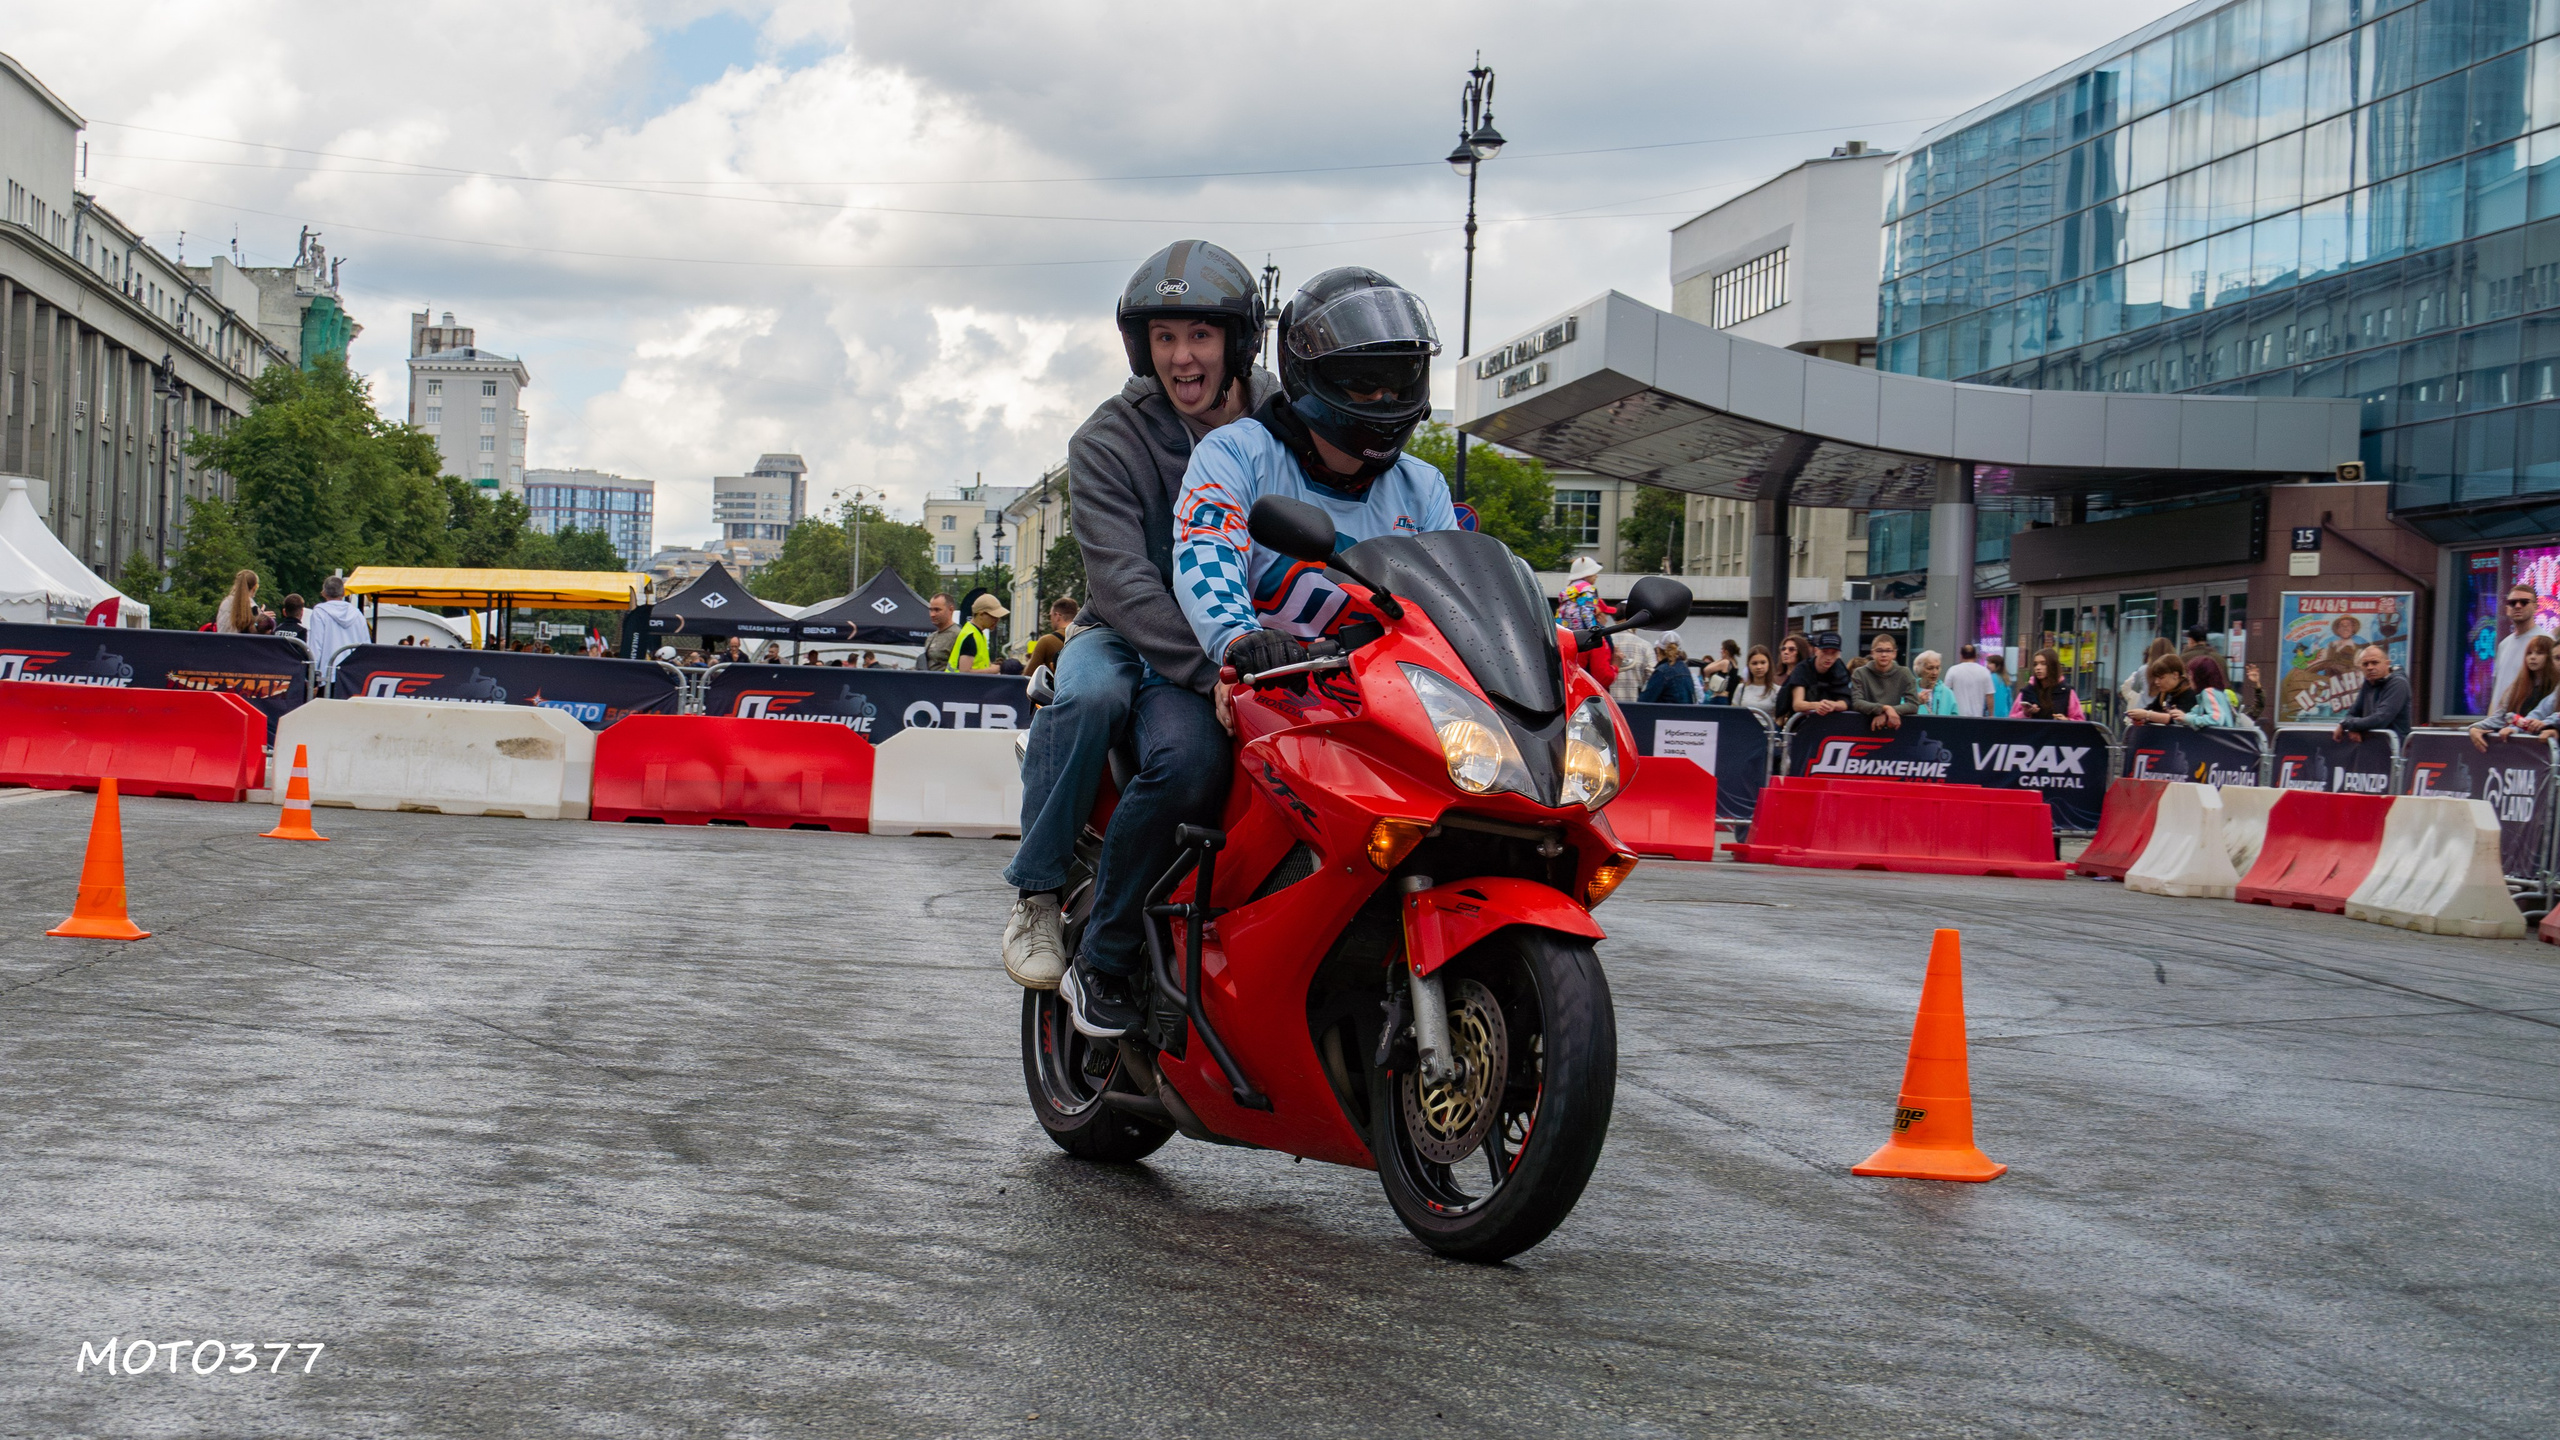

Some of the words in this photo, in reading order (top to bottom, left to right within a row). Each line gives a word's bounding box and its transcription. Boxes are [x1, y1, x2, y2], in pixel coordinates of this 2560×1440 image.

[2296, 530, 2315, 543] 15
[2300, 599, 2348, 611] 2/4/8/9
[737, 624, 764, 632] UNLEASH
[1257, 695, 1304, 719] HONDA
[1665, 729, 1708, 737] Ирбитский
[1810, 742, 1952, 778] ДВИЖЕНИЕ
[1972, 743, 2091, 774] VIRAX
[2018, 775, 2084, 788] CAPITAL
[2344, 772, 2389, 793] PRINZIP
[2503, 768, 2536, 796] SIMA
[2500, 795, 2535, 822] LAND
